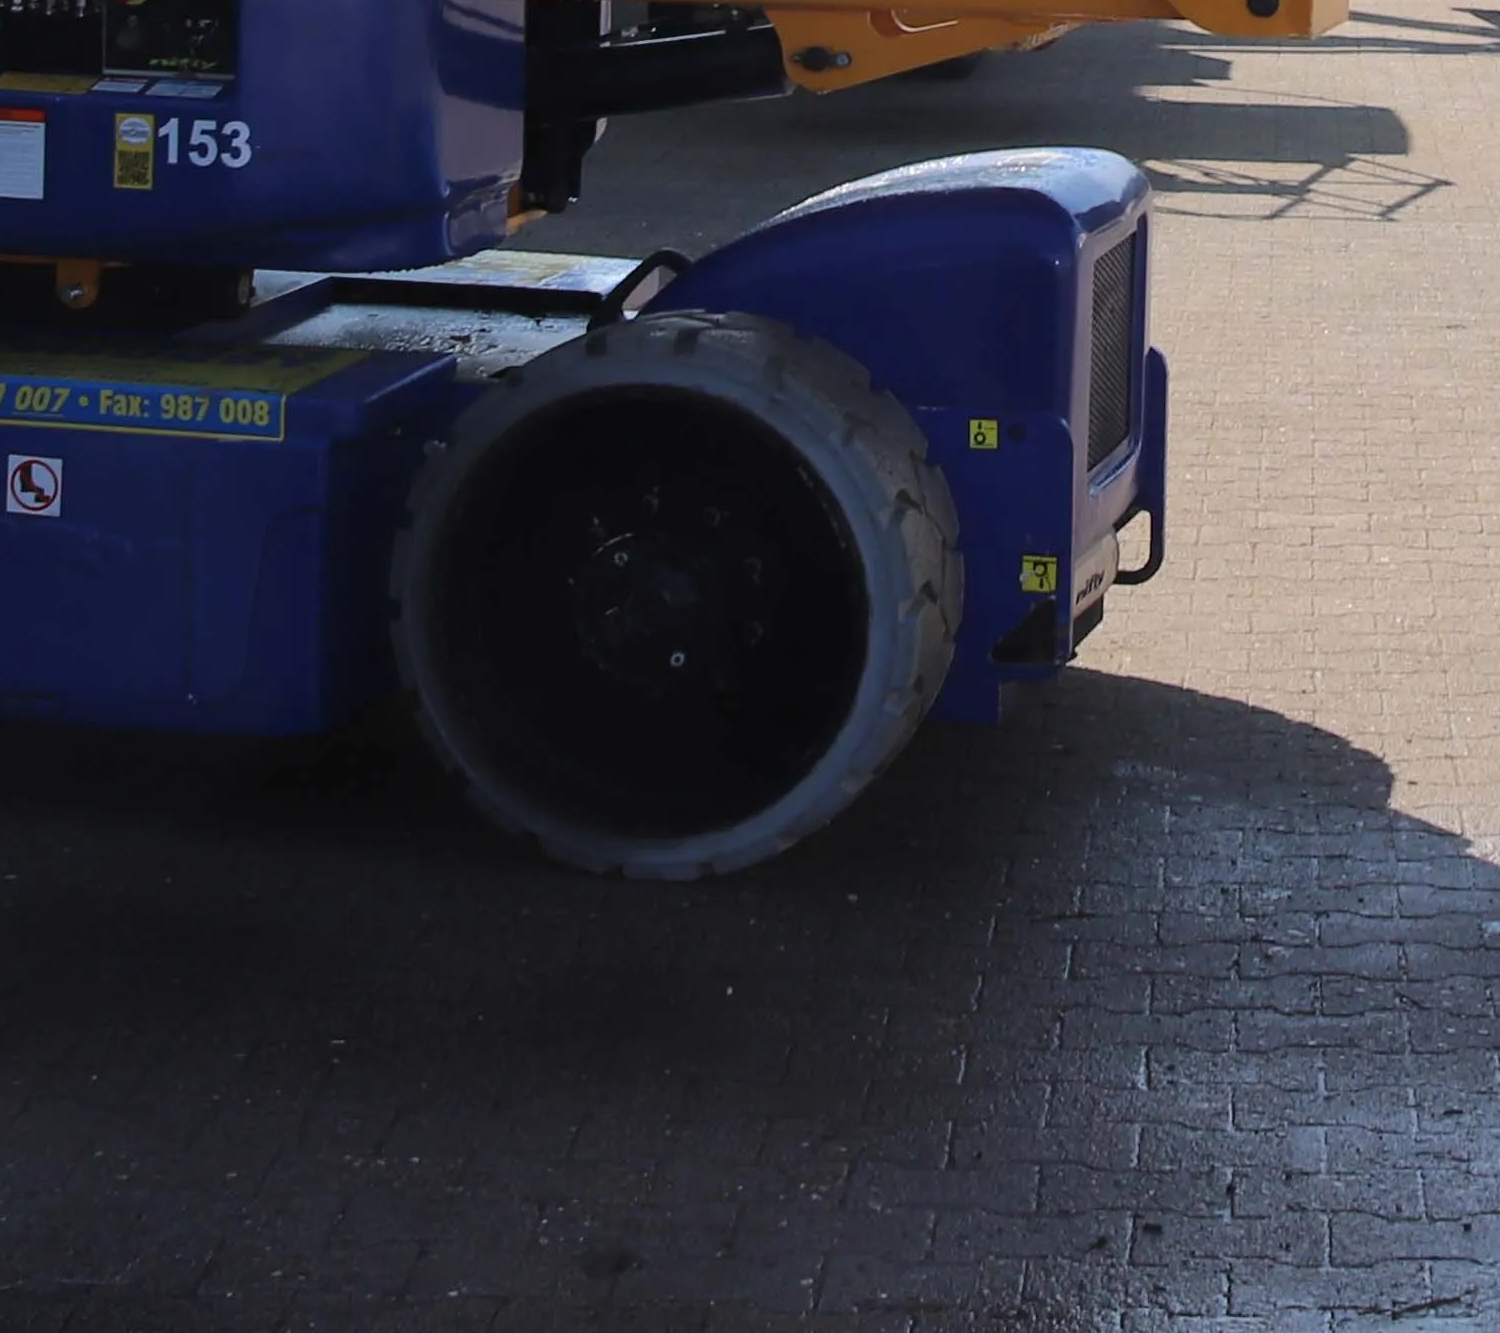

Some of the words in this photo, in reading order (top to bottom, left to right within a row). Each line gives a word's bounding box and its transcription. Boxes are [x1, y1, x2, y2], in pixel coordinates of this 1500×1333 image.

[157, 117, 253, 169] 153
[15, 386, 73, 412] 007
[100, 388, 150, 418] Fax:
[160, 393, 210, 421] 987
[219, 397, 270, 426] 008
